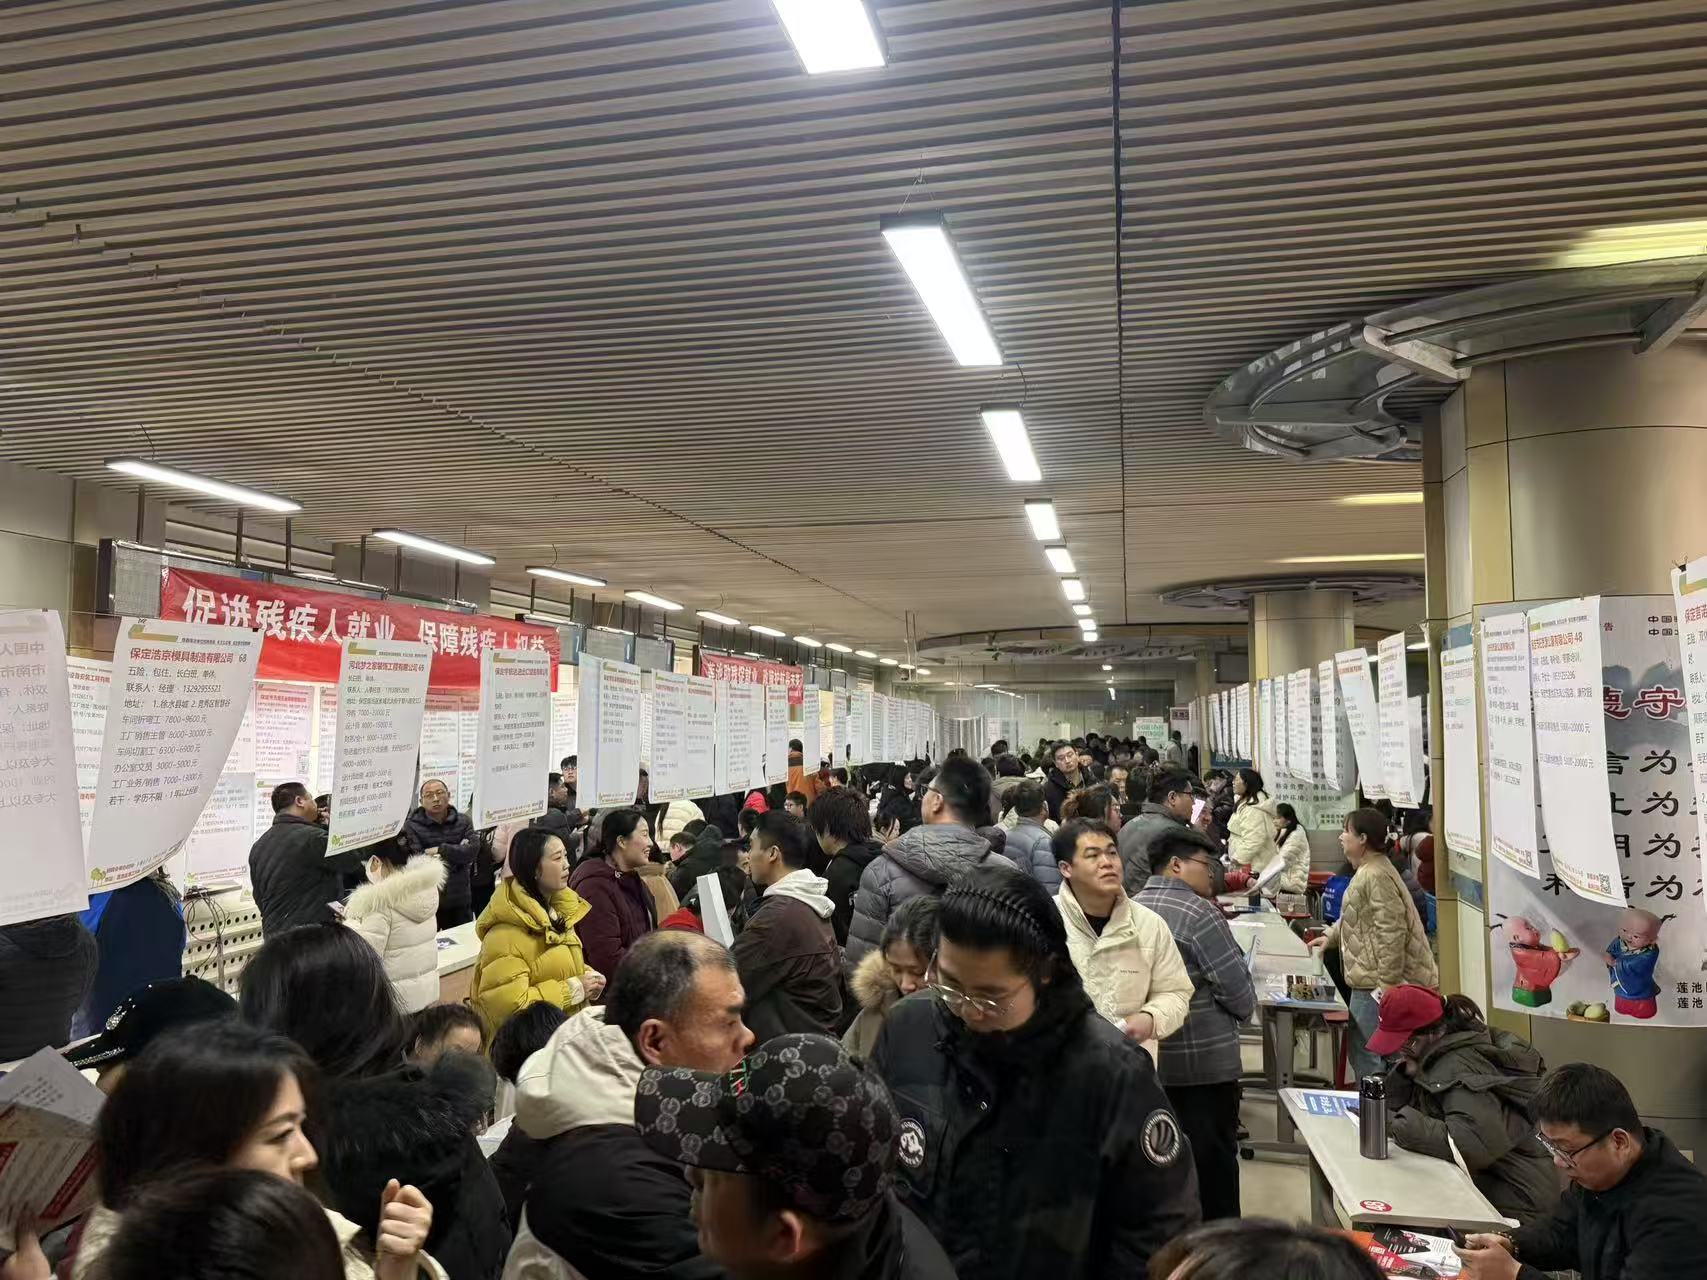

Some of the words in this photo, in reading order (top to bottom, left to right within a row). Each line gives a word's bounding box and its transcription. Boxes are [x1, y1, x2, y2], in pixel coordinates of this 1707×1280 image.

[182, 586, 395, 645] 促进残疾人就业
[130, 647, 233, 664] 保定浩京模具制造有限公司
[239, 653, 248, 662] 68
